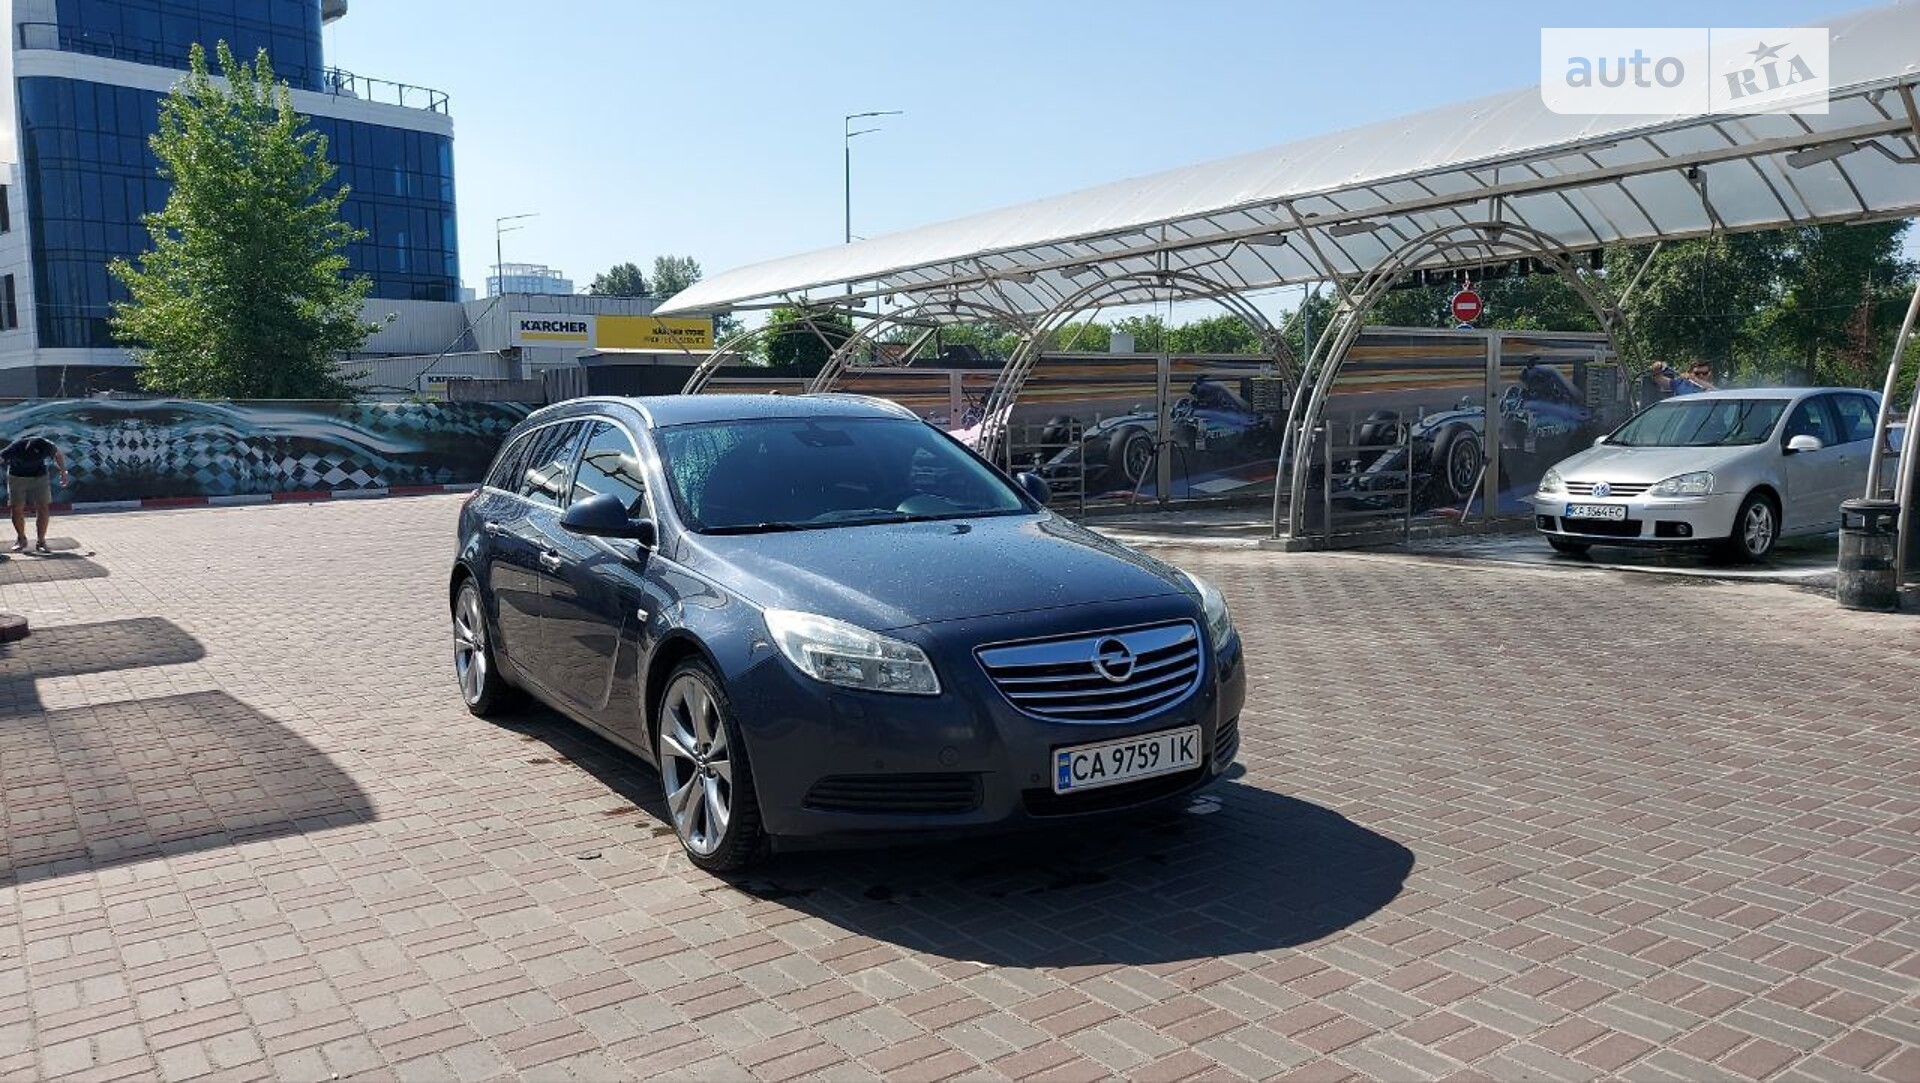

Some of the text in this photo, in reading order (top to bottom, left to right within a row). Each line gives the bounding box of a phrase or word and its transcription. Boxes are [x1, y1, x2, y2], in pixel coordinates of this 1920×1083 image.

[520, 320, 588, 333] KÄRCHER
[1072, 735, 1194, 780] CA 9759 IK
